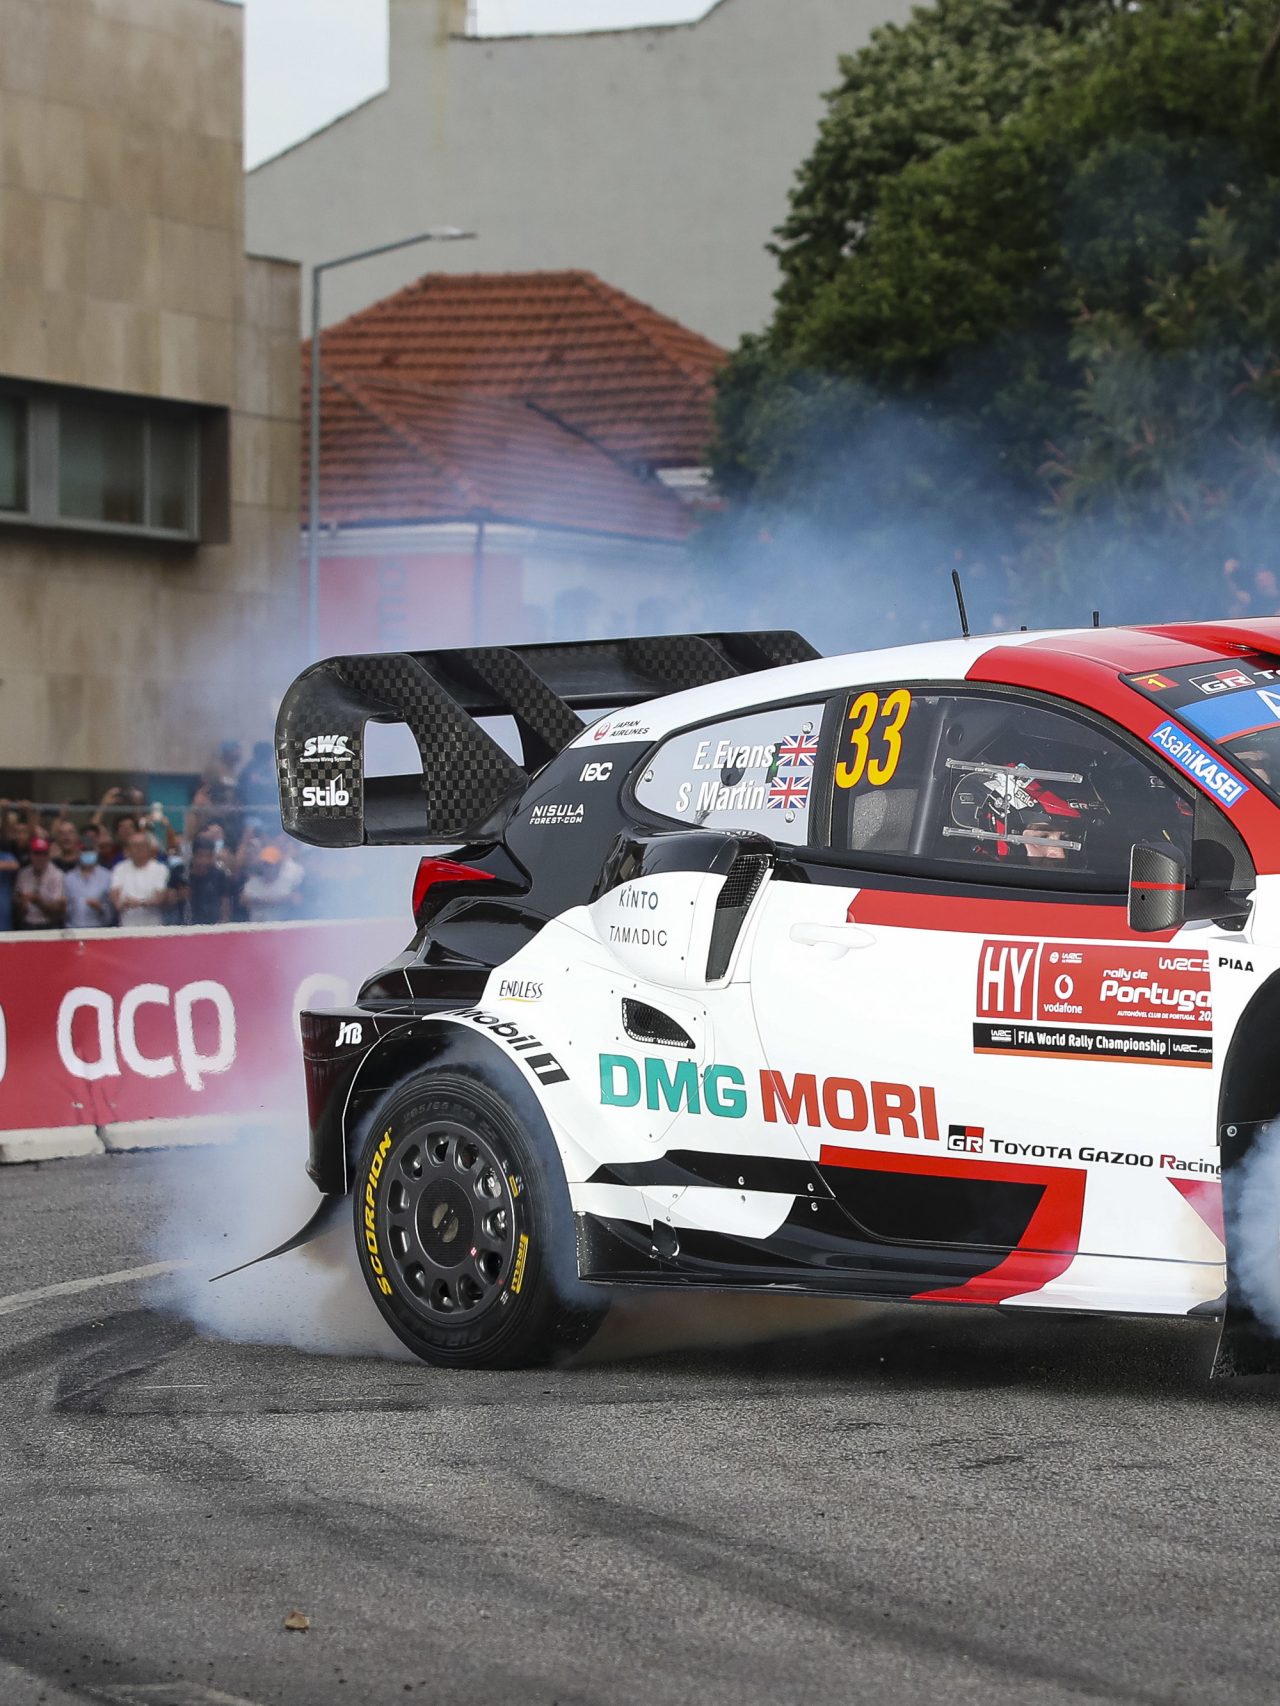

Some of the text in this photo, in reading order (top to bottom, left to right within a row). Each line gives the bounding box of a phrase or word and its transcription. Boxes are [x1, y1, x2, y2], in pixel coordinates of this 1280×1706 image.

[1200, 674, 1254, 694] GR
[610, 727, 650, 737] AIRLINES
[613, 720, 641, 729] JAPAN
[303, 735, 351, 757] SWS
[835, 689, 911, 788] 33
[1153, 726, 1243, 803] AsahiKASEI
[302, 773, 350, 807] Stilo
[675, 781, 766, 812] S Martin
[532, 804, 584, 816] NISULA
[609, 926, 668, 947] TAMADIC
[1103, 968, 1148, 981] rally de
[1219, 957, 1254, 973] PIAA
[499, 980, 543, 998] ENDLESS
[982, 946, 1034, 1013] HY
[1043, 1002, 1083, 1014] vodafone
[57, 980, 237, 1091] acp
[335, 1021, 363, 1047] JTB
[446, 1008, 543, 1051] Mobil
[1018, 1031, 1035, 1045] FIA
[1037, 1031, 1066, 1047] World
[1068, 1034, 1093, 1050] Rally
[1096, 1036, 1166, 1055] Championship
[599, 1053, 939, 1141] DMG MORI
[948, 1131, 984, 1153] GR
[989, 1138, 1073, 1160] TOYOTA
[1078, 1147, 1153, 1167] GAZOO
[365, 1130, 394, 1297] SCORPION
